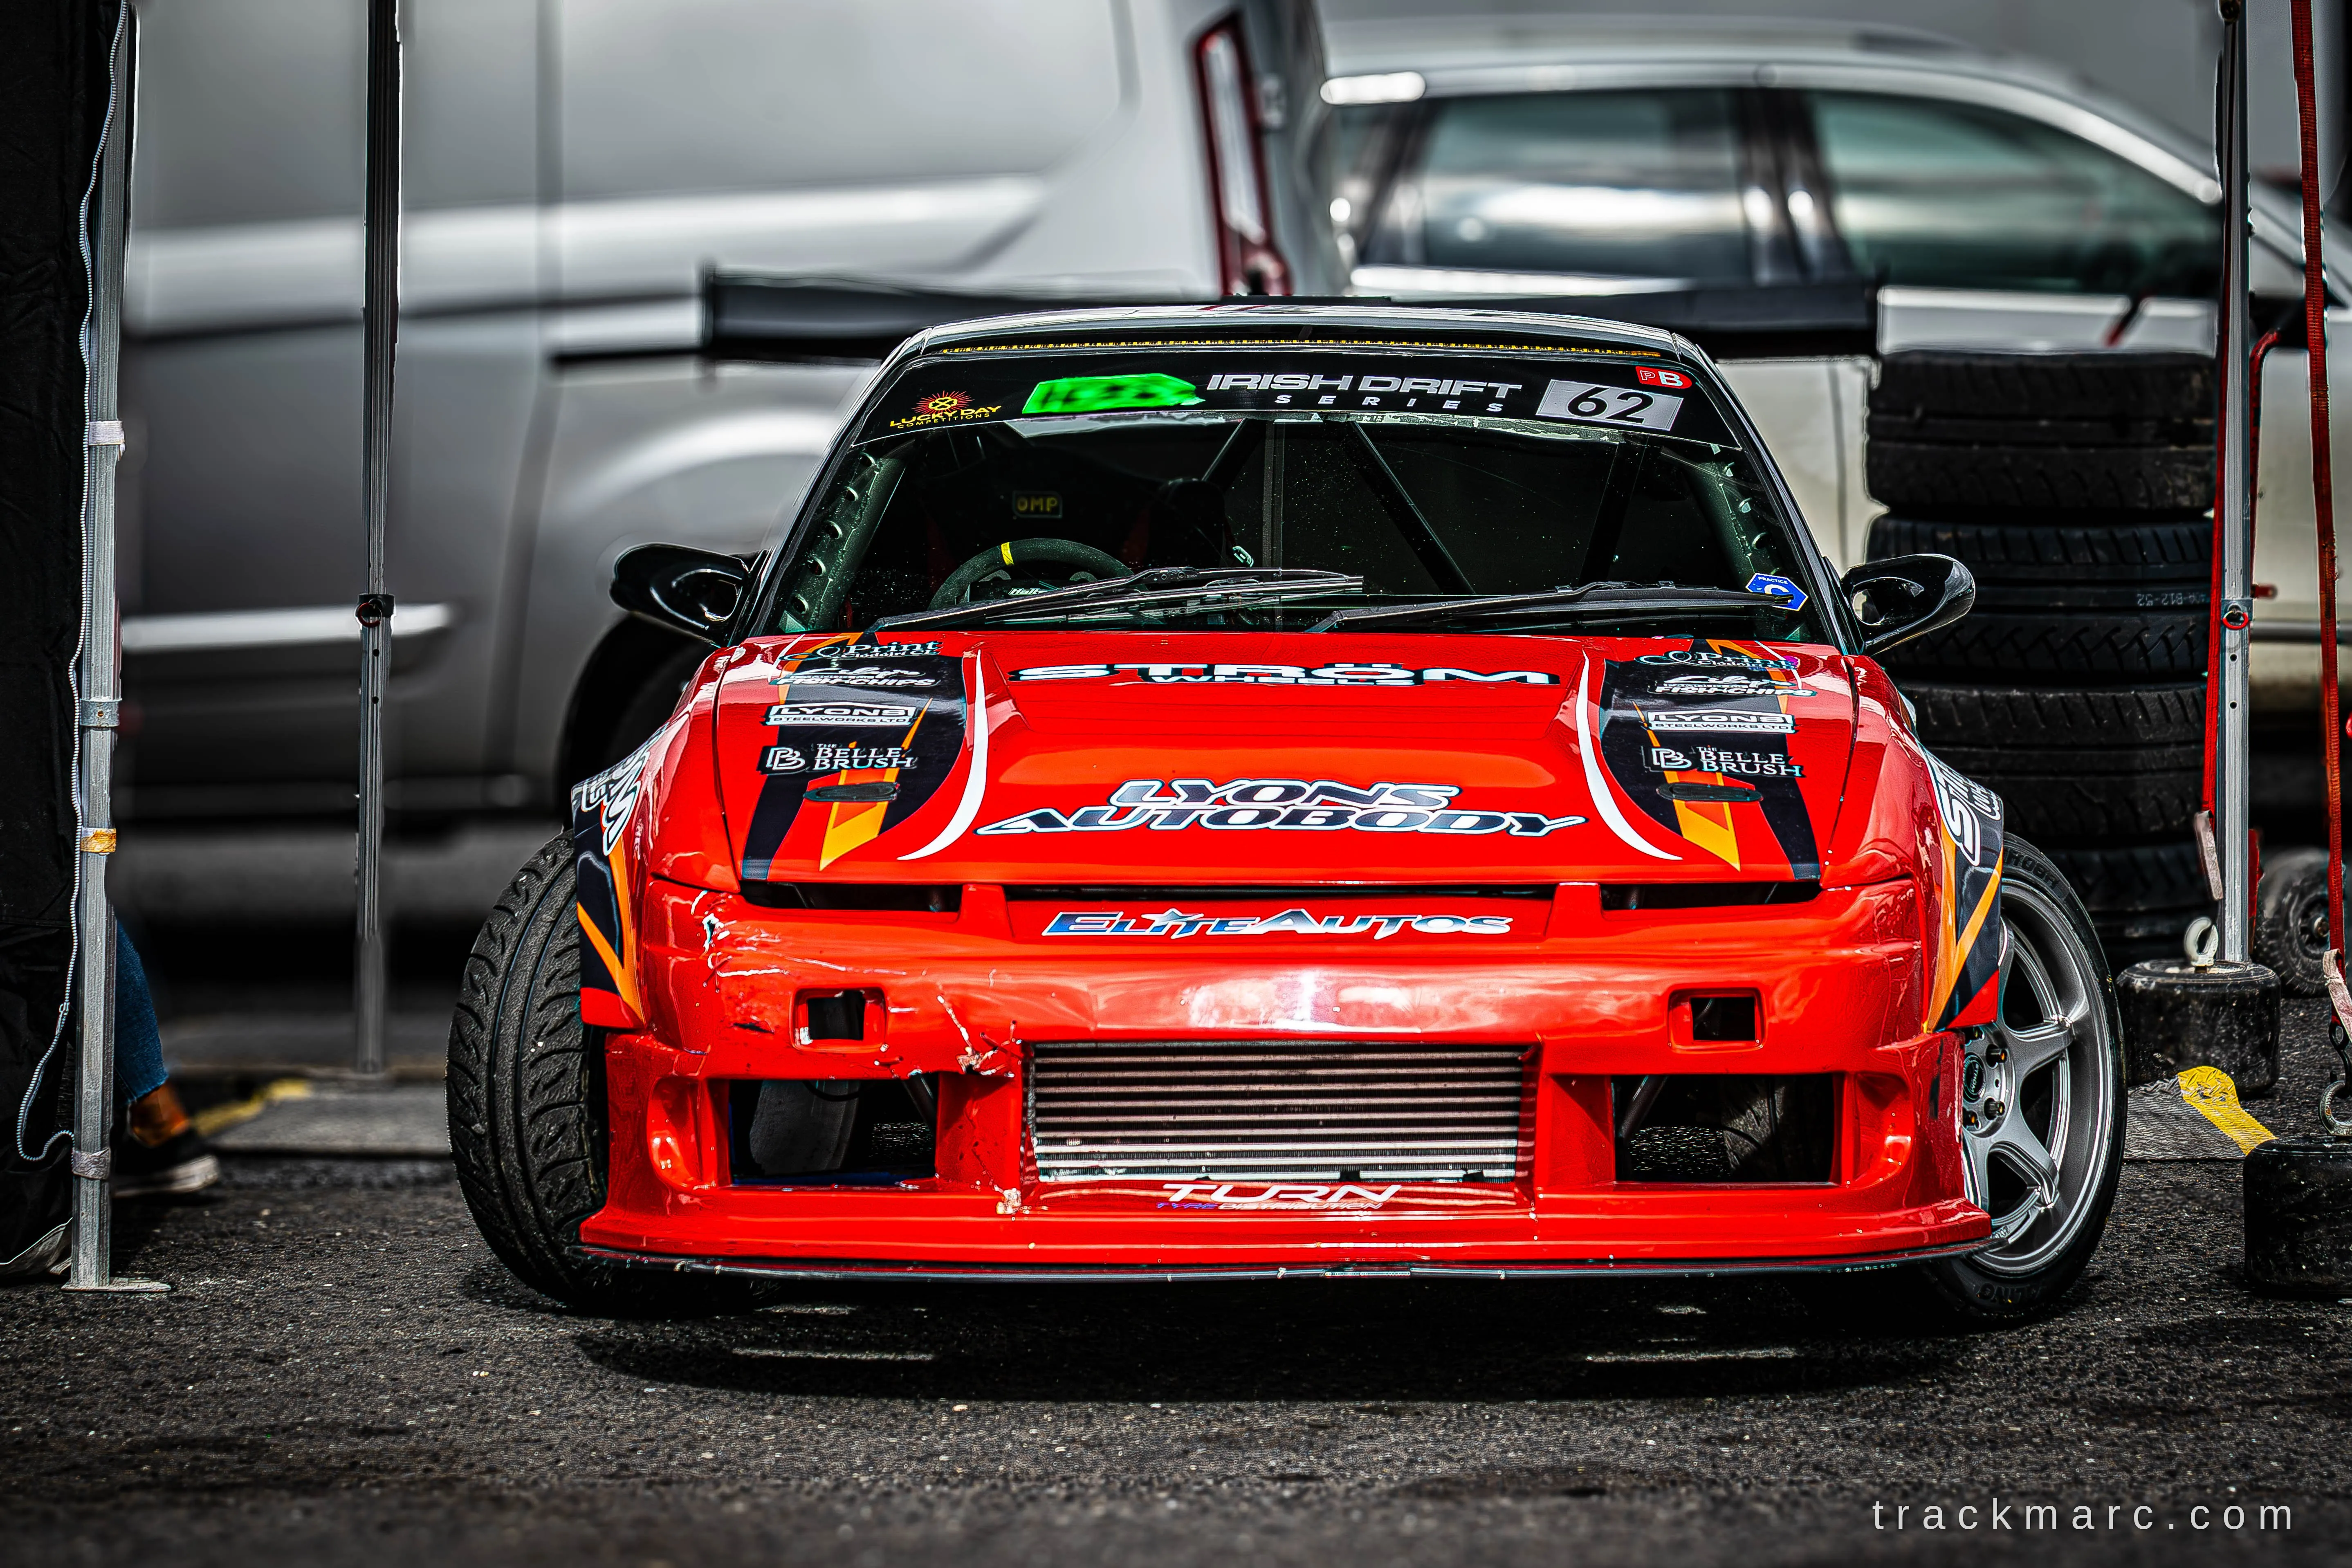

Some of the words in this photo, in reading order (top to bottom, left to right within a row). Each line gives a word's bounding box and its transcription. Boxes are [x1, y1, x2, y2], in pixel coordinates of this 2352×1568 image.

[1207, 375, 1353, 390] IRISH
[1359, 375, 1522, 399] DRIFT
[1275, 395, 1503, 412] SERIES
[1567, 386, 1655, 424] 62
[890, 410, 958, 427] LUCKY
[960, 405, 1001, 416] DAY
[897, 413, 990, 428] COMPETITIONS
[1017, 497, 1057, 512] OMP
[1757, 576, 1788, 584] PRACTICE
[844, 641, 939, 654] Print
[1696, 652, 1794, 666] Print
[1151, 675, 1415, 685] WHEELS
[1728, 688, 1814, 696] CHIPS
[780, 707, 907, 716] LYONS
[1659, 714, 1785, 723] LYONS
[815, 747, 902, 758] BELLE
[1700, 750, 1786, 764] BELLE
[812, 757, 914, 770] BRUSH
[1701, 760, 1802, 777] BRUSH
[1109, 779, 1463, 810] LYONS
[974, 805, 1589, 837] AUTOBODY
[1162, 1183, 1403, 1202] TURN
[1218, 1202, 1384, 1210] DISTRIBUTION
